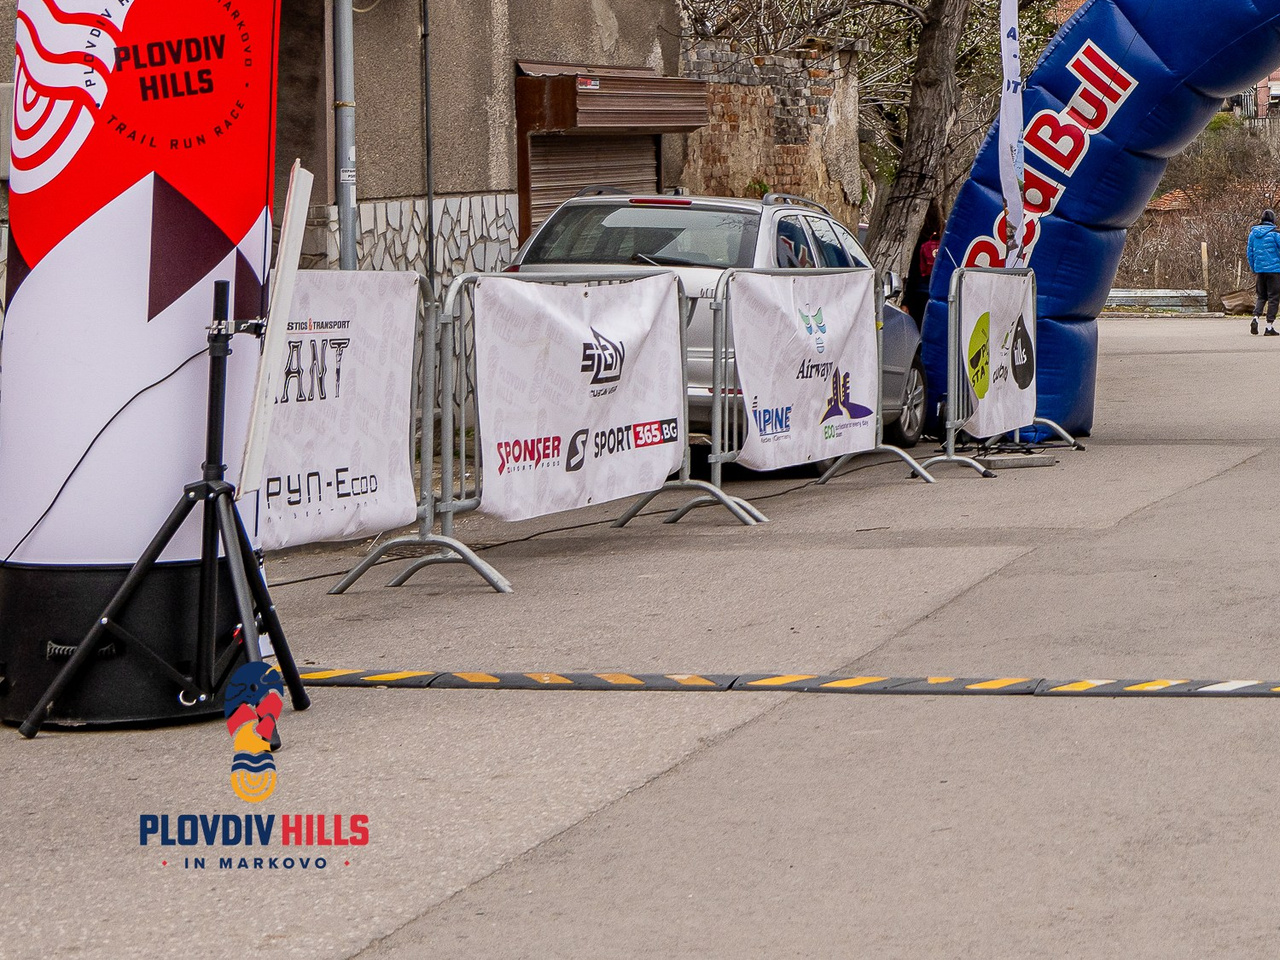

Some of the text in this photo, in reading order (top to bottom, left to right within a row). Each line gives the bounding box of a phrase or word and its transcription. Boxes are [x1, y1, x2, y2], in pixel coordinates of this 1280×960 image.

[83, 9, 112, 88] PLOVDIV
[113, 33, 226, 72] PLOVDIV
[139, 68, 214, 102] HILLS
[1023, 44, 1133, 171] Bull
[106, 99, 245, 150] TRAIL RUN RACE
[274, 338, 350, 405] ANT
[497, 435, 562, 476] SPONSER
